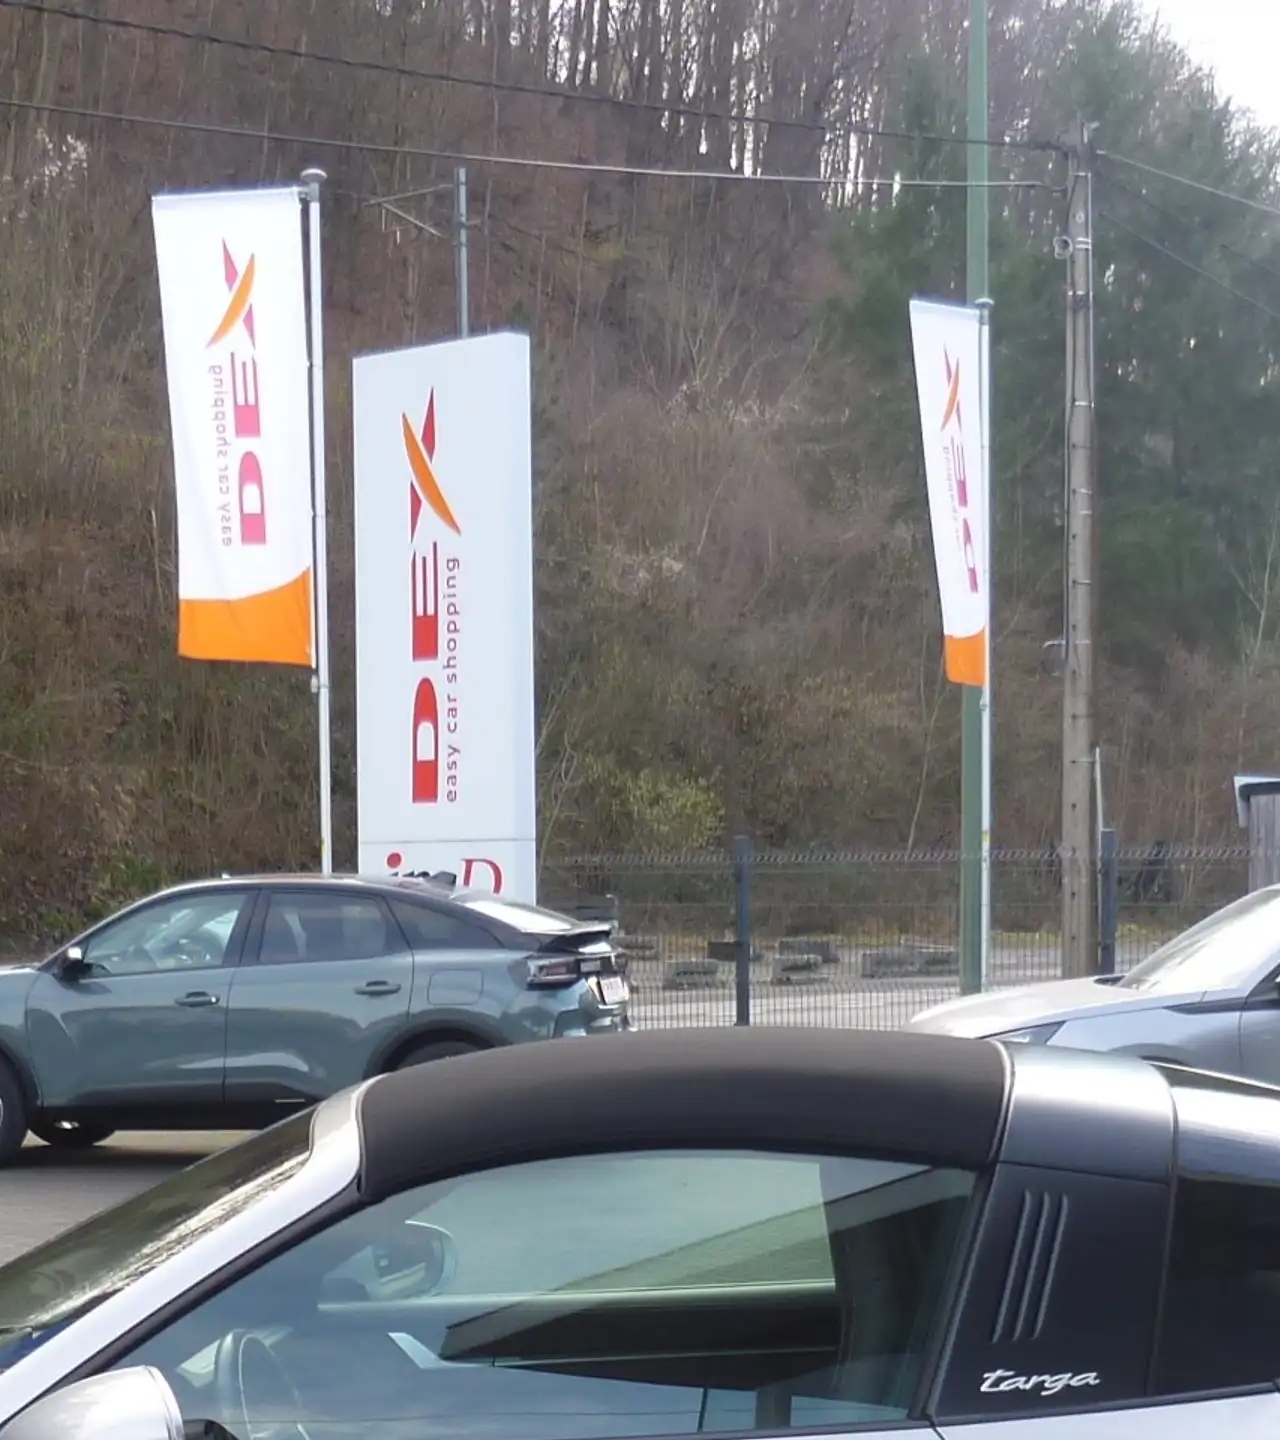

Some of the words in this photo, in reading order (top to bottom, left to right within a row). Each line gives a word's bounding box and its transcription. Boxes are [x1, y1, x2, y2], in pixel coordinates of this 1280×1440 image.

[401, 385, 462, 803] DEX
[443, 557, 461, 684] shopping
[446, 693, 458, 734] car
[446, 744, 461, 803] easy
[980, 1368, 1101, 1396] targa
